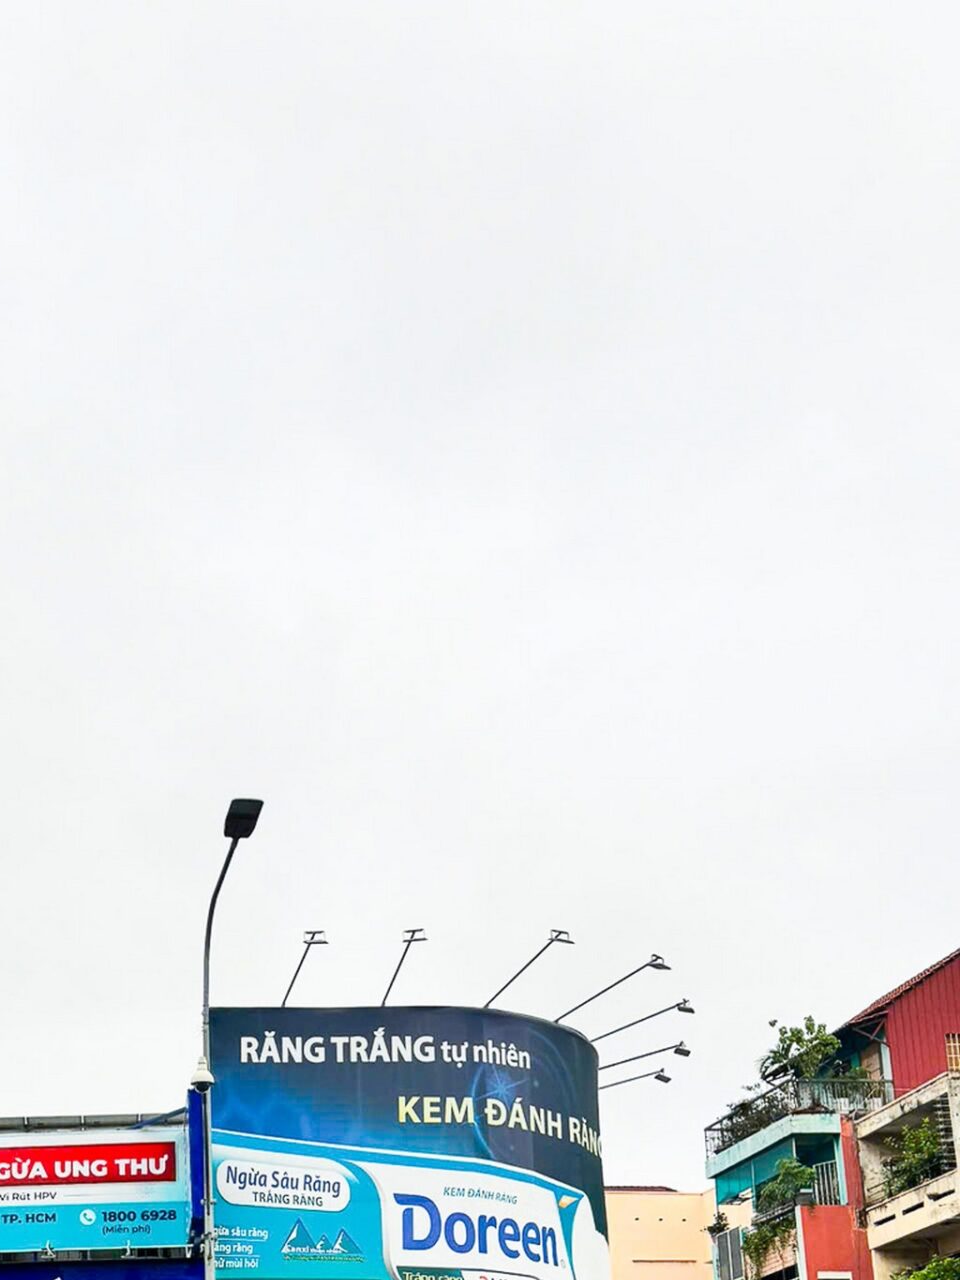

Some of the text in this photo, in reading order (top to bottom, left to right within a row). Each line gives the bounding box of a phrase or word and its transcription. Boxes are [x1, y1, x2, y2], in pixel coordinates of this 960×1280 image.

[239, 1026, 532, 1070] RĂNG TRẮNG tự nhiên
[397, 1095, 475, 1125] KEM
[483, 1097, 563, 1140] ĐÁNH
[53, 1159, 108, 1178] UNG
[113, 1153, 169, 1177] THƯ
[225, 1165, 341, 1198] Ngừa Sâu Răng
[442, 1186, 466, 1198] KEM
[467, 1186, 495, 1201] ĐÁNH
[12, 1191, 31, 1202] Rút
[33, 1191, 57, 1201] HPV
[1, 1213, 23, 1225] TP.
[25, 1212, 57, 1224] HCM
[101, 1209, 178, 1223] 1800 6928
[393, 1192, 560, 1267] Doreen
